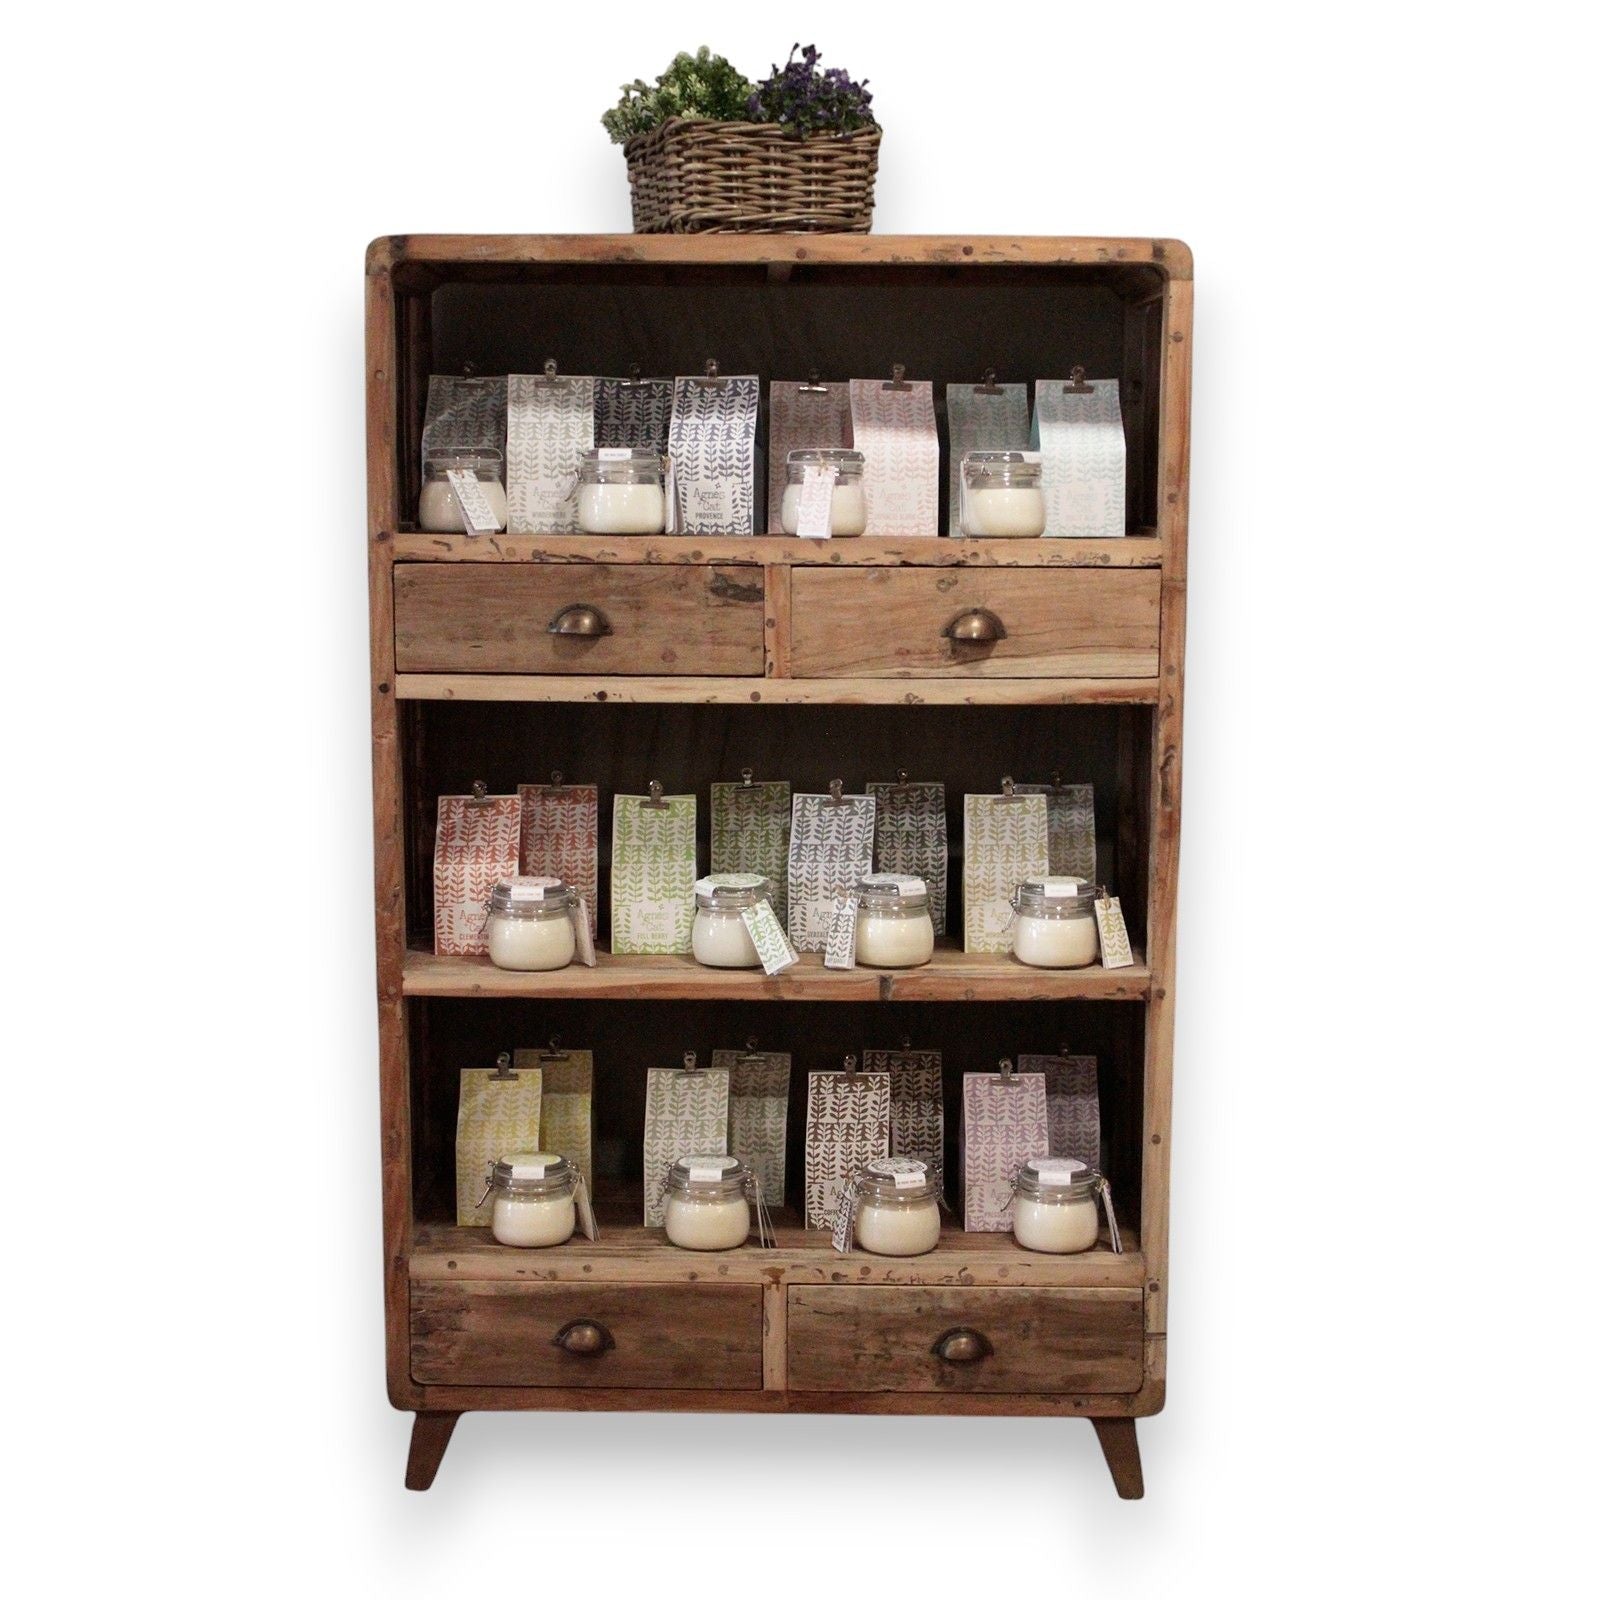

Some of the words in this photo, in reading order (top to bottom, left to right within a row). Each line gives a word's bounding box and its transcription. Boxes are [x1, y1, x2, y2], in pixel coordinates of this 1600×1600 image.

[693, 487, 726, 502] Agnes
[695, 512, 724, 520] PROVENCE
[460, 909, 488, 925] Agne
[459, 933, 490, 941] CLEMENTIN
